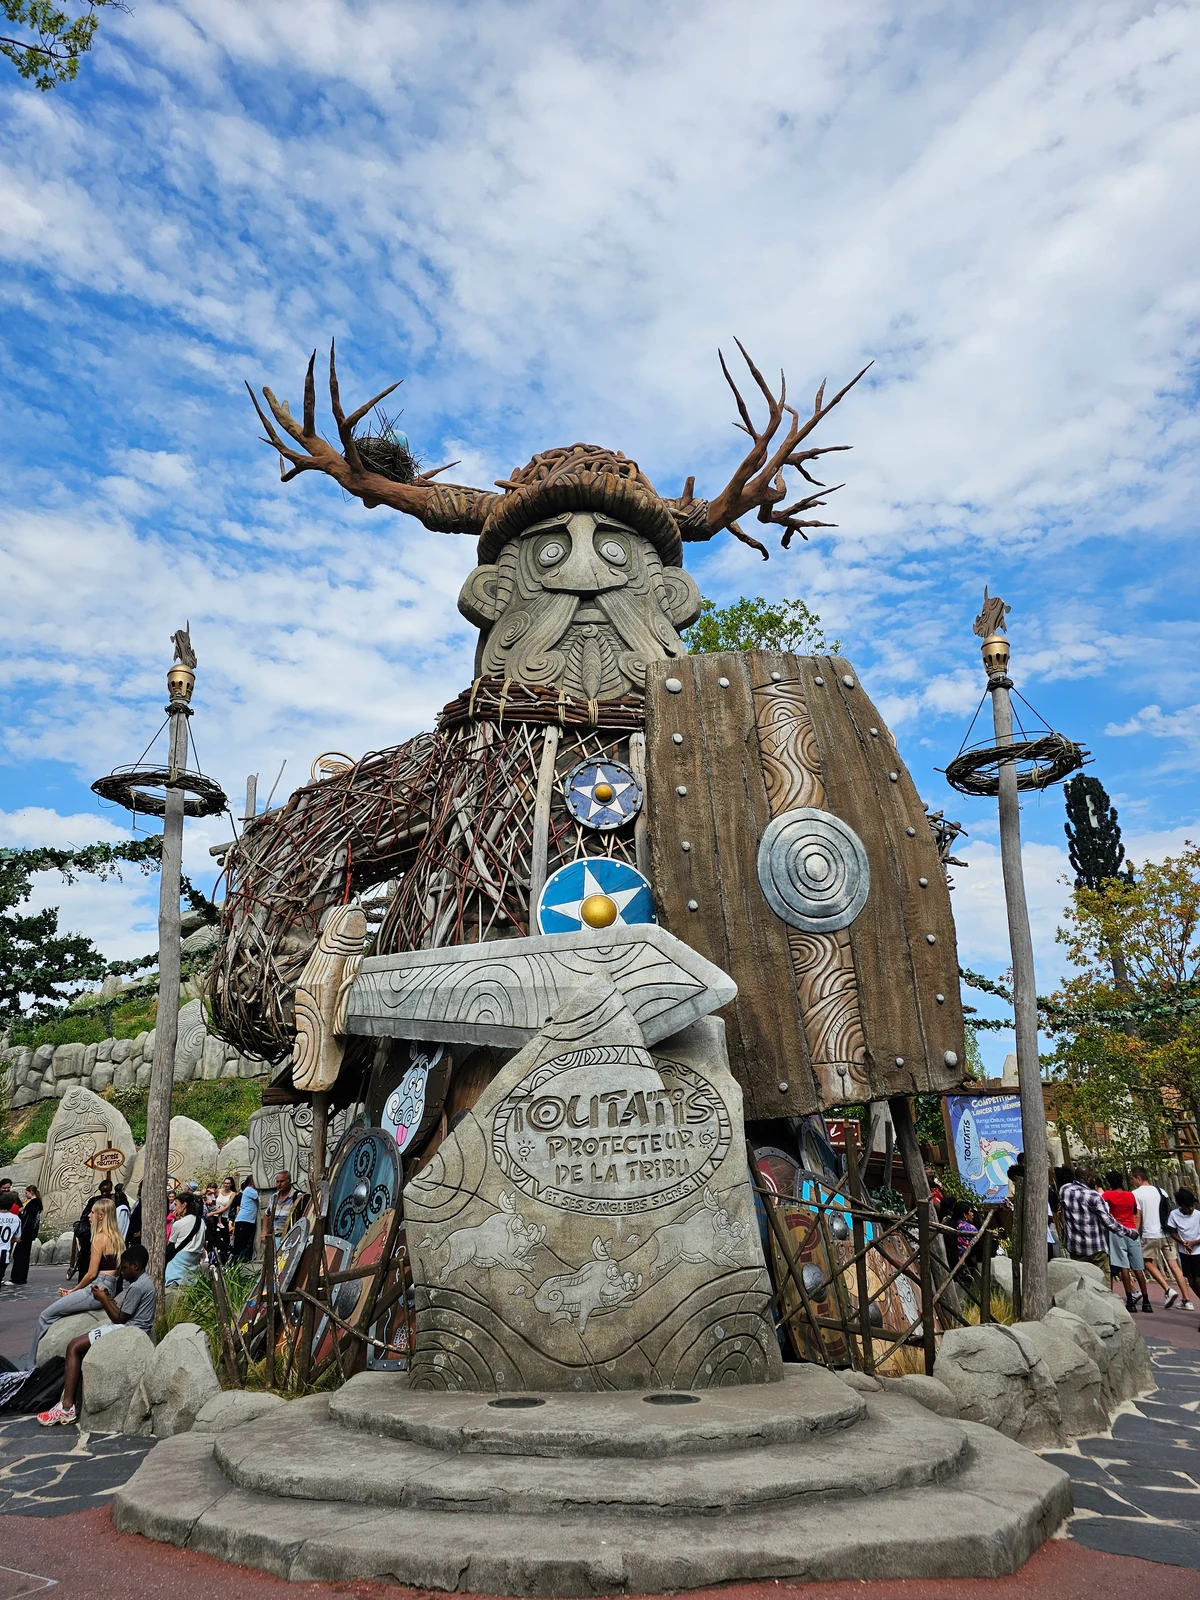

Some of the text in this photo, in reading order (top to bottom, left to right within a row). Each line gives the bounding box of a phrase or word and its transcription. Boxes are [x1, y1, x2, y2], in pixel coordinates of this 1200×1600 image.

[545, 1129, 695, 1160] PROTECTEUR
[555, 1164, 584, 1186] DE
[590, 1162, 619, 1185] LA
[544, 1190, 559, 1202] ET
[561, 1196, 584, 1210] SES
